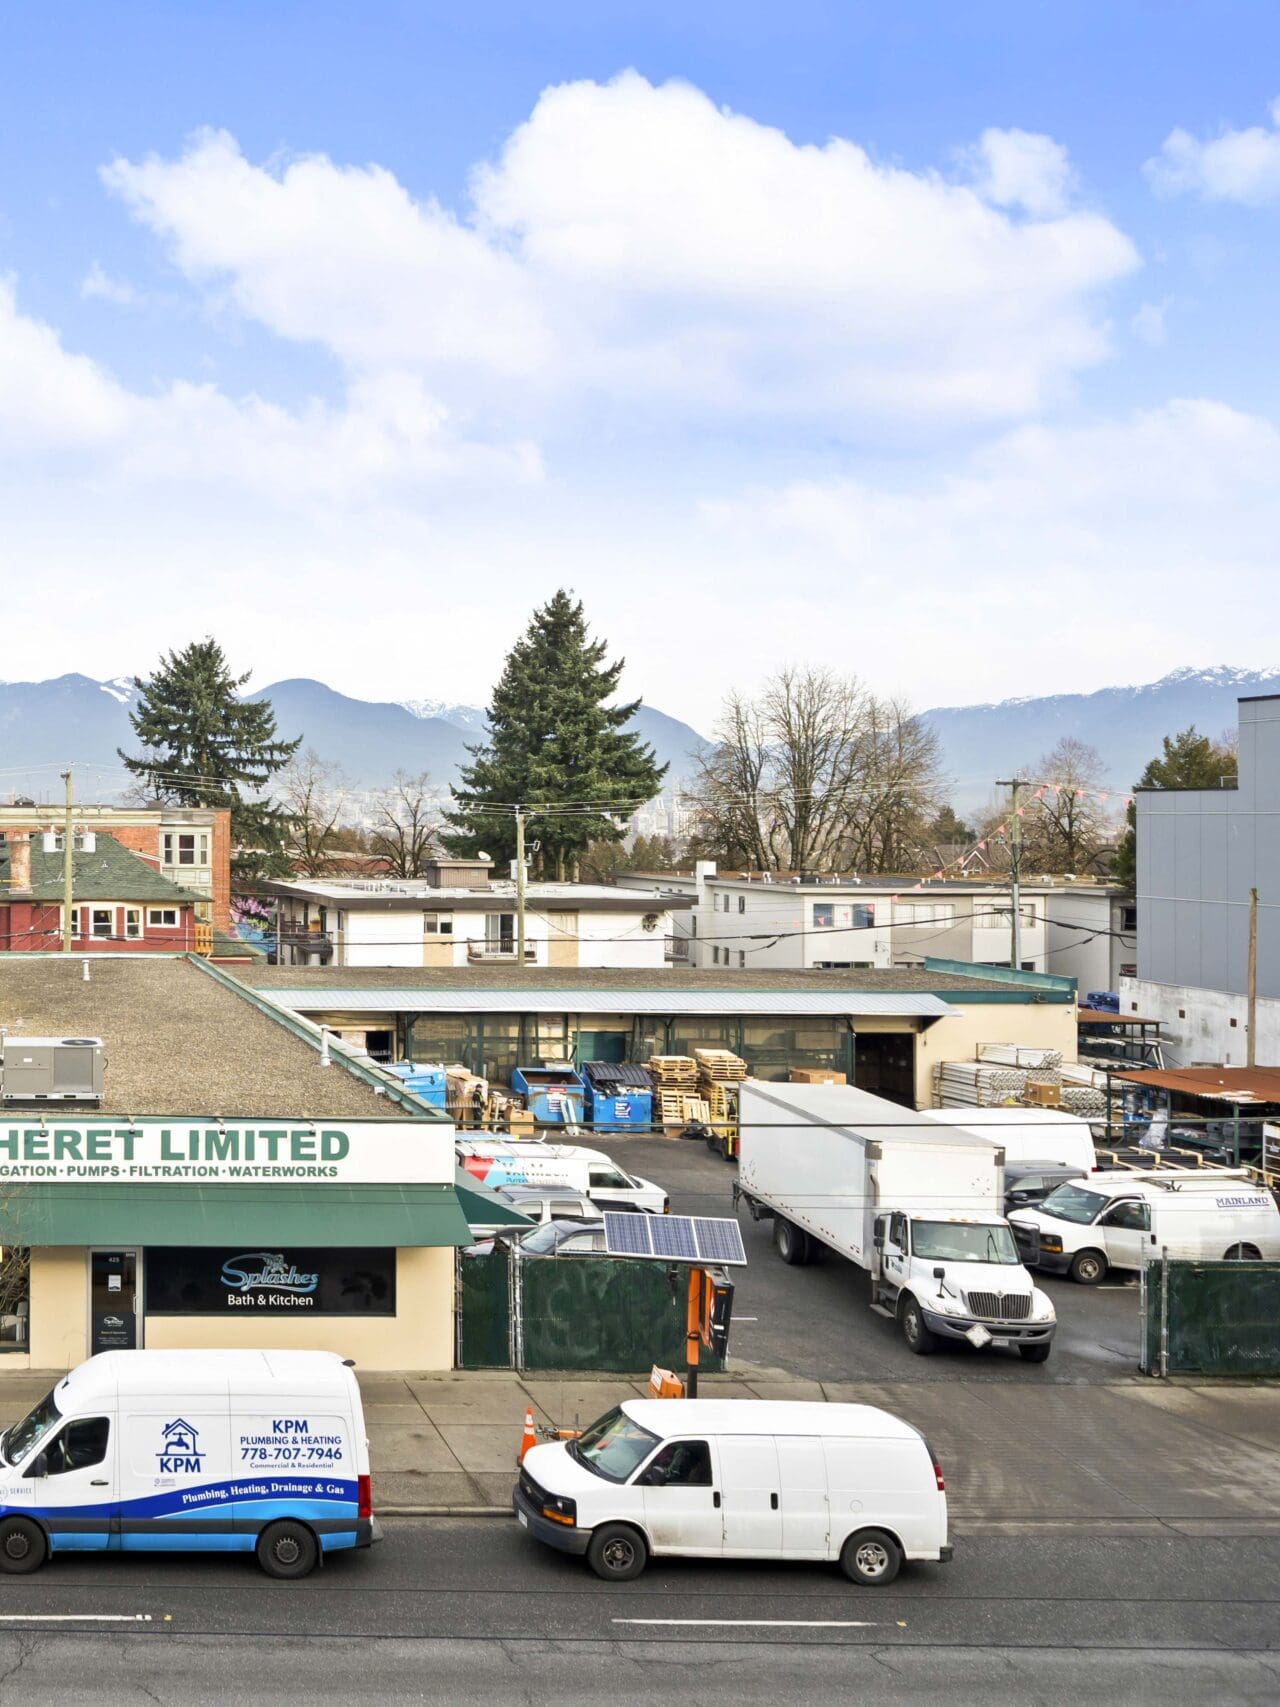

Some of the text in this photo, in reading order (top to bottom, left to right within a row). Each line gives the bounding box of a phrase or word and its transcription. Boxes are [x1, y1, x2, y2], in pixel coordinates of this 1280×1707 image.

[160, 1130, 351, 1162] LIMITED
[66, 1166, 120, 1177] PUMPS
[129, 1166, 219, 1178] FILTRATION
[228, 1166, 338, 1178] WATERWORKS
[220, 1252, 320, 1293] Splashes
[227, 1293, 313, 1306] Bath & Kitchen
[272, 1420, 309, 1434] KPM
[240, 1436, 342, 1445] PLUMBING & HEATING
[241, 1447, 343, 1460] 778-707-7946
[160, 1458, 201, 1473] KPM
[182, 1482, 345, 1504] Plumbing, Heating, Drainage & Gas
